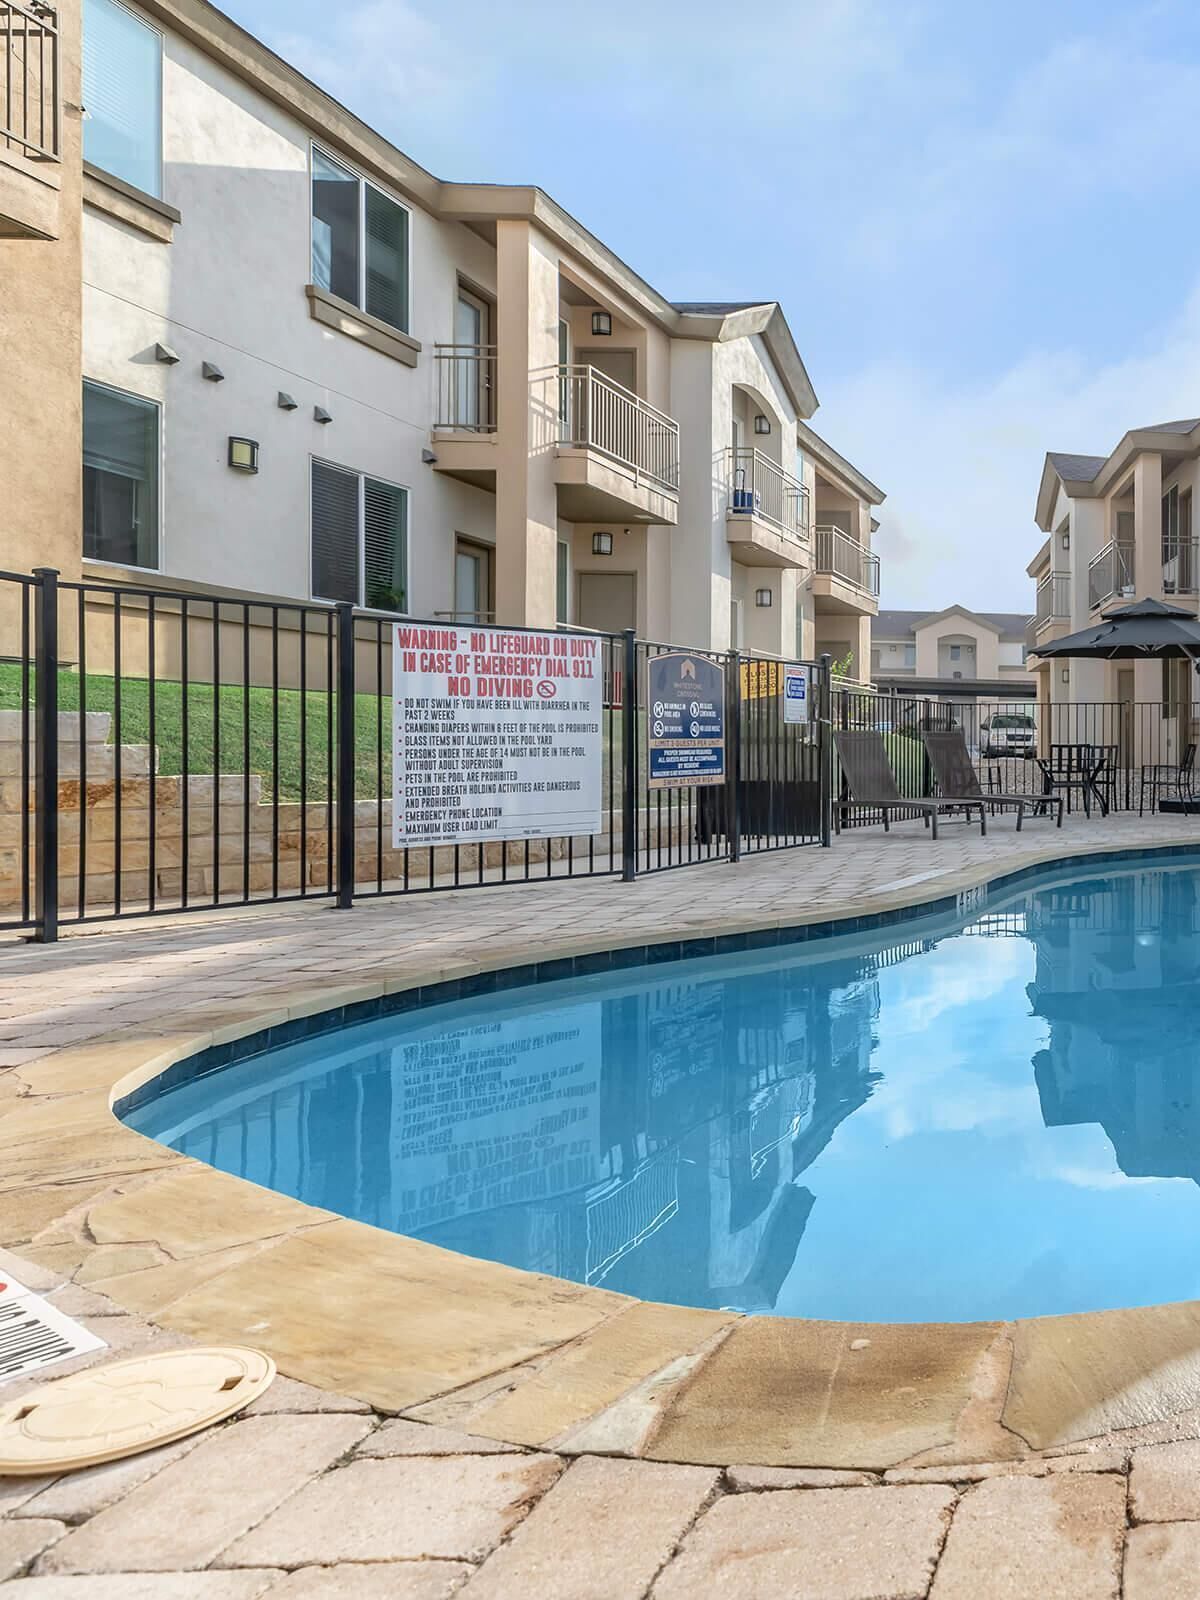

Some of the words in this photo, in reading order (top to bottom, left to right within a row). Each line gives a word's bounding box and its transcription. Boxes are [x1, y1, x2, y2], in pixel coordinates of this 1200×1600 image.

[398, 627, 457, 651] WARNING
[471, 632, 486, 653] NO
[490, 633, 550, 655] LIFEGUARD
[553, 638, 567, 656] ON
[570, 639, 597, 658] DUTY
[403, 651, 416, 672] IN
[420, 652, 452, 673] CASE
[456, 654, 471, 674] OF
[474, 654, 542, 677] EMERGENCY
[546, 658, 570, 677] DIAL
[573, 660, 594, 678] 911
[448, 676, 471, 697] NO
[477, 677, 533, 698] DIVING
[404, 698, 414, 709] DO
[416, 698, 429, 709] NOT
[431, 698, 452, 709] SWIM
[453, 698, 460, 709] IF
[461, 699, 475, 709] YOU
[476, 699, 493, 709] HAVE
[495, 700, 511, 710] BEEN
[512, 700, 522, 710] ILL
[523, 700, 540, 710] WITH
[541, 701, 570, 711] DIARRHEA
[571, 701, 578, 711] IN
[579, 701, 590, 711] THE
[404, 710, 421, 720] PAST
[424, 710, 429, 720] 2
[430, 710, 455, 720] WEEKS
[404, 723, 440, 733] CHANGING
[441, 723, 469, 733] DIAPERS
[471, 723, 495, 733] WITHIN
[503, 723, 518, 733] FEET
[519, 723, 527, 733] OF
[529, 723, 540, 733] THE
[542, 723, 556, 733] POOL
[558, 723, 564, 733] IS
[566, 723, 598, 733] PROHIBITED
[404, 736, 428, 746] GLASS
[429, 736, 451, 746] ITEMS
[452, 736, 465, 745] NOT
[466, 736, 497, 745] ALLOWED
[499, 736, 506, 745] IN
[507, 736, 519, 745] THE
[520, 736, 536, 745] POOL
[537, 736, 553, 745] YARD
[405, 749, 437, 759] PERSONS
[438, 749, 460, 759] UNDER
[462, 748, 474, 758] THE
[475, 748, 488, 758] AGE
[490, 748, 498, 758] OF
[500, 748, 508, 758] 14
[510, 747, 528, 757] MUST
[529, 747, 541, 757] NOT
[542, 747, 550, 757] BE
[551, 747, 558, 757] IN
[559, 747, 570, 757] THE
[571, 747, 586, 757] POOL
[405, 760, 437, 771] WITHOUT
[438, 760, 459, 770] ADULT
[460, 759, 504, 769] SUPERVISION
[405, 773, 423, 784] PETS
[424, 773, 432, 783] IN
[434, 772, 446, 783] THE
[448, 772, 465, 782] POOL
[466, 771, 479, 782] ARE
[481, 771, 518, 781] PROHIBITED
[405, 786, 440, 797] EXTENDED
[441, 785, 467, 795] BREATH
[469, 784, 496, 794] HOLDING
[497, 782, 532, 793] ACTIVITIES
[533, 782, 545, 792] ARE
[546, 781, 581, 791] DANGEROUS
[405, 798, 420, 808] AND
[421, 797, 461, 807] PROHIBITED
[405, 810, 447, 821] EMERGENCY
[448, 809, 470, 819] PHONE
[472, 807, 503, 818] LOCATION
[405, 823, 440, 834] MAXIMUM
[442, 822, 460, 832] USER
[461, 821, 479, 831] LOAD
[480, 819, 498, 830] LIMIT
